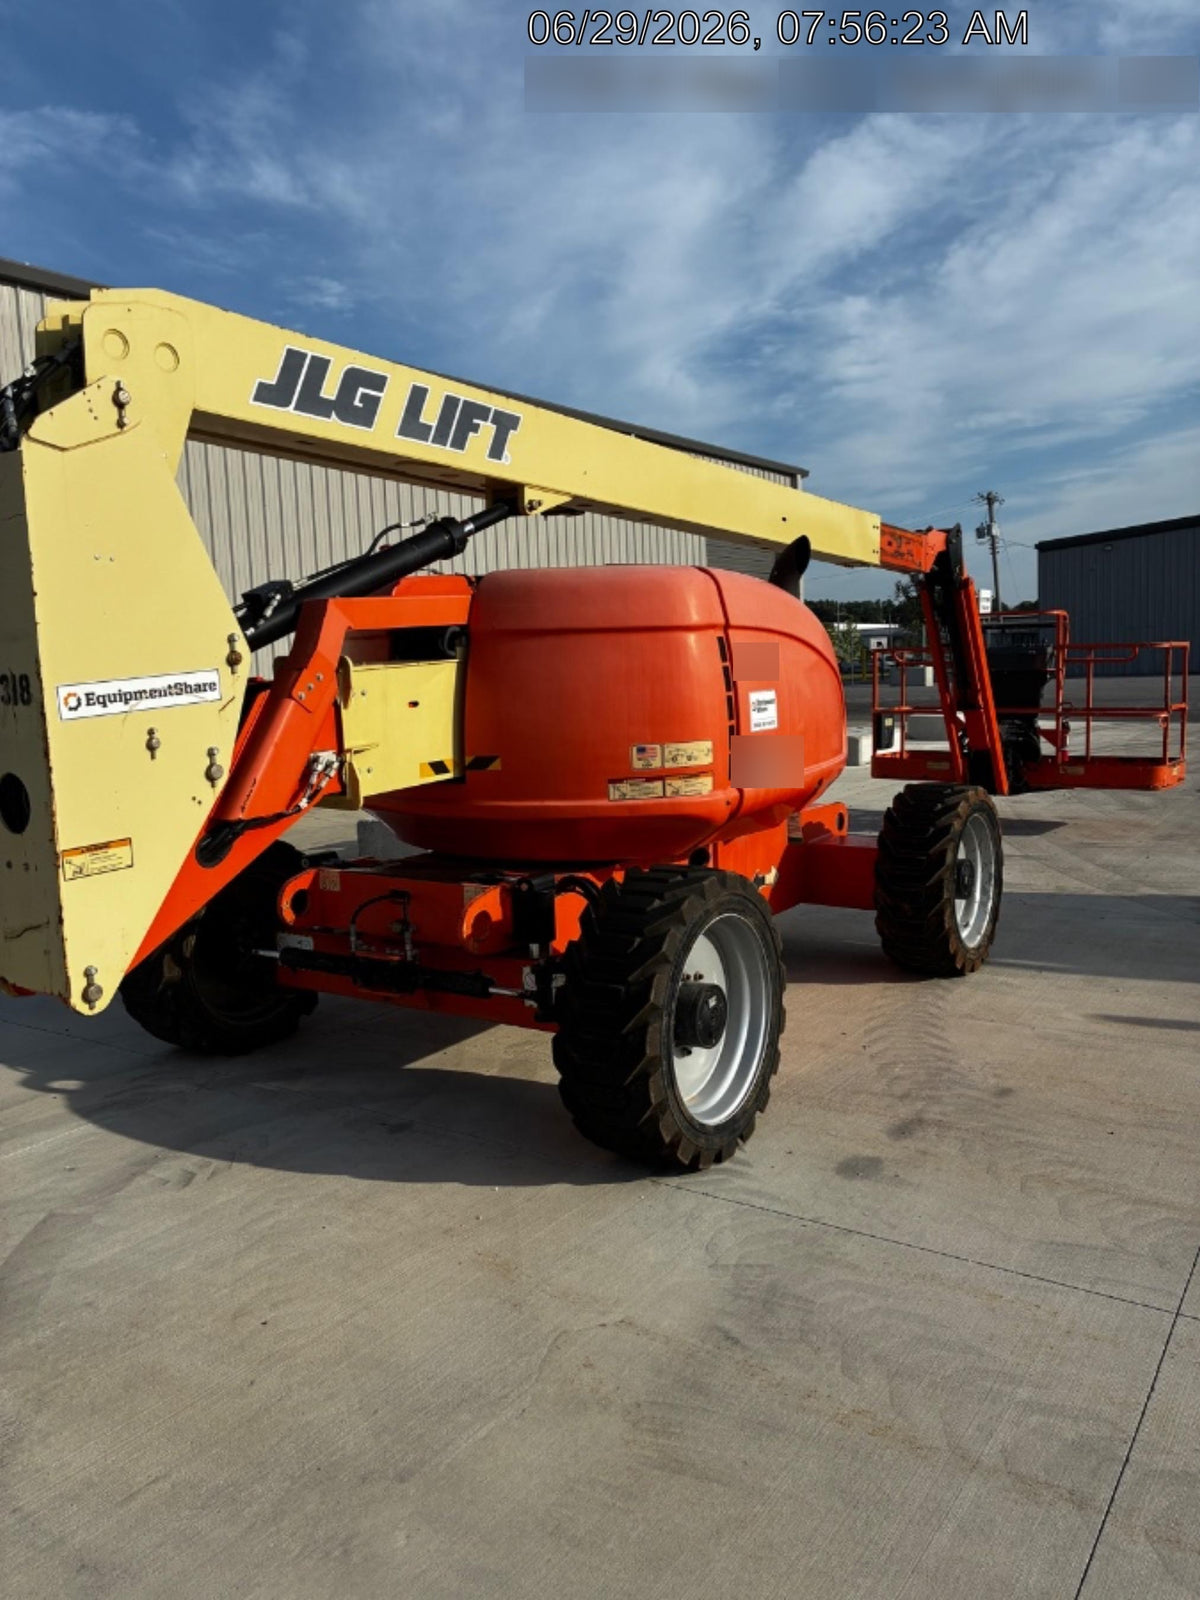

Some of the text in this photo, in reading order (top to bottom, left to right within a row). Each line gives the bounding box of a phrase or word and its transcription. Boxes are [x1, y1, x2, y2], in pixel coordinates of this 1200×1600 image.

[251, 345, 522, 463] JLG LIFT
[84, 680, 218, 708] EquipmentShare
